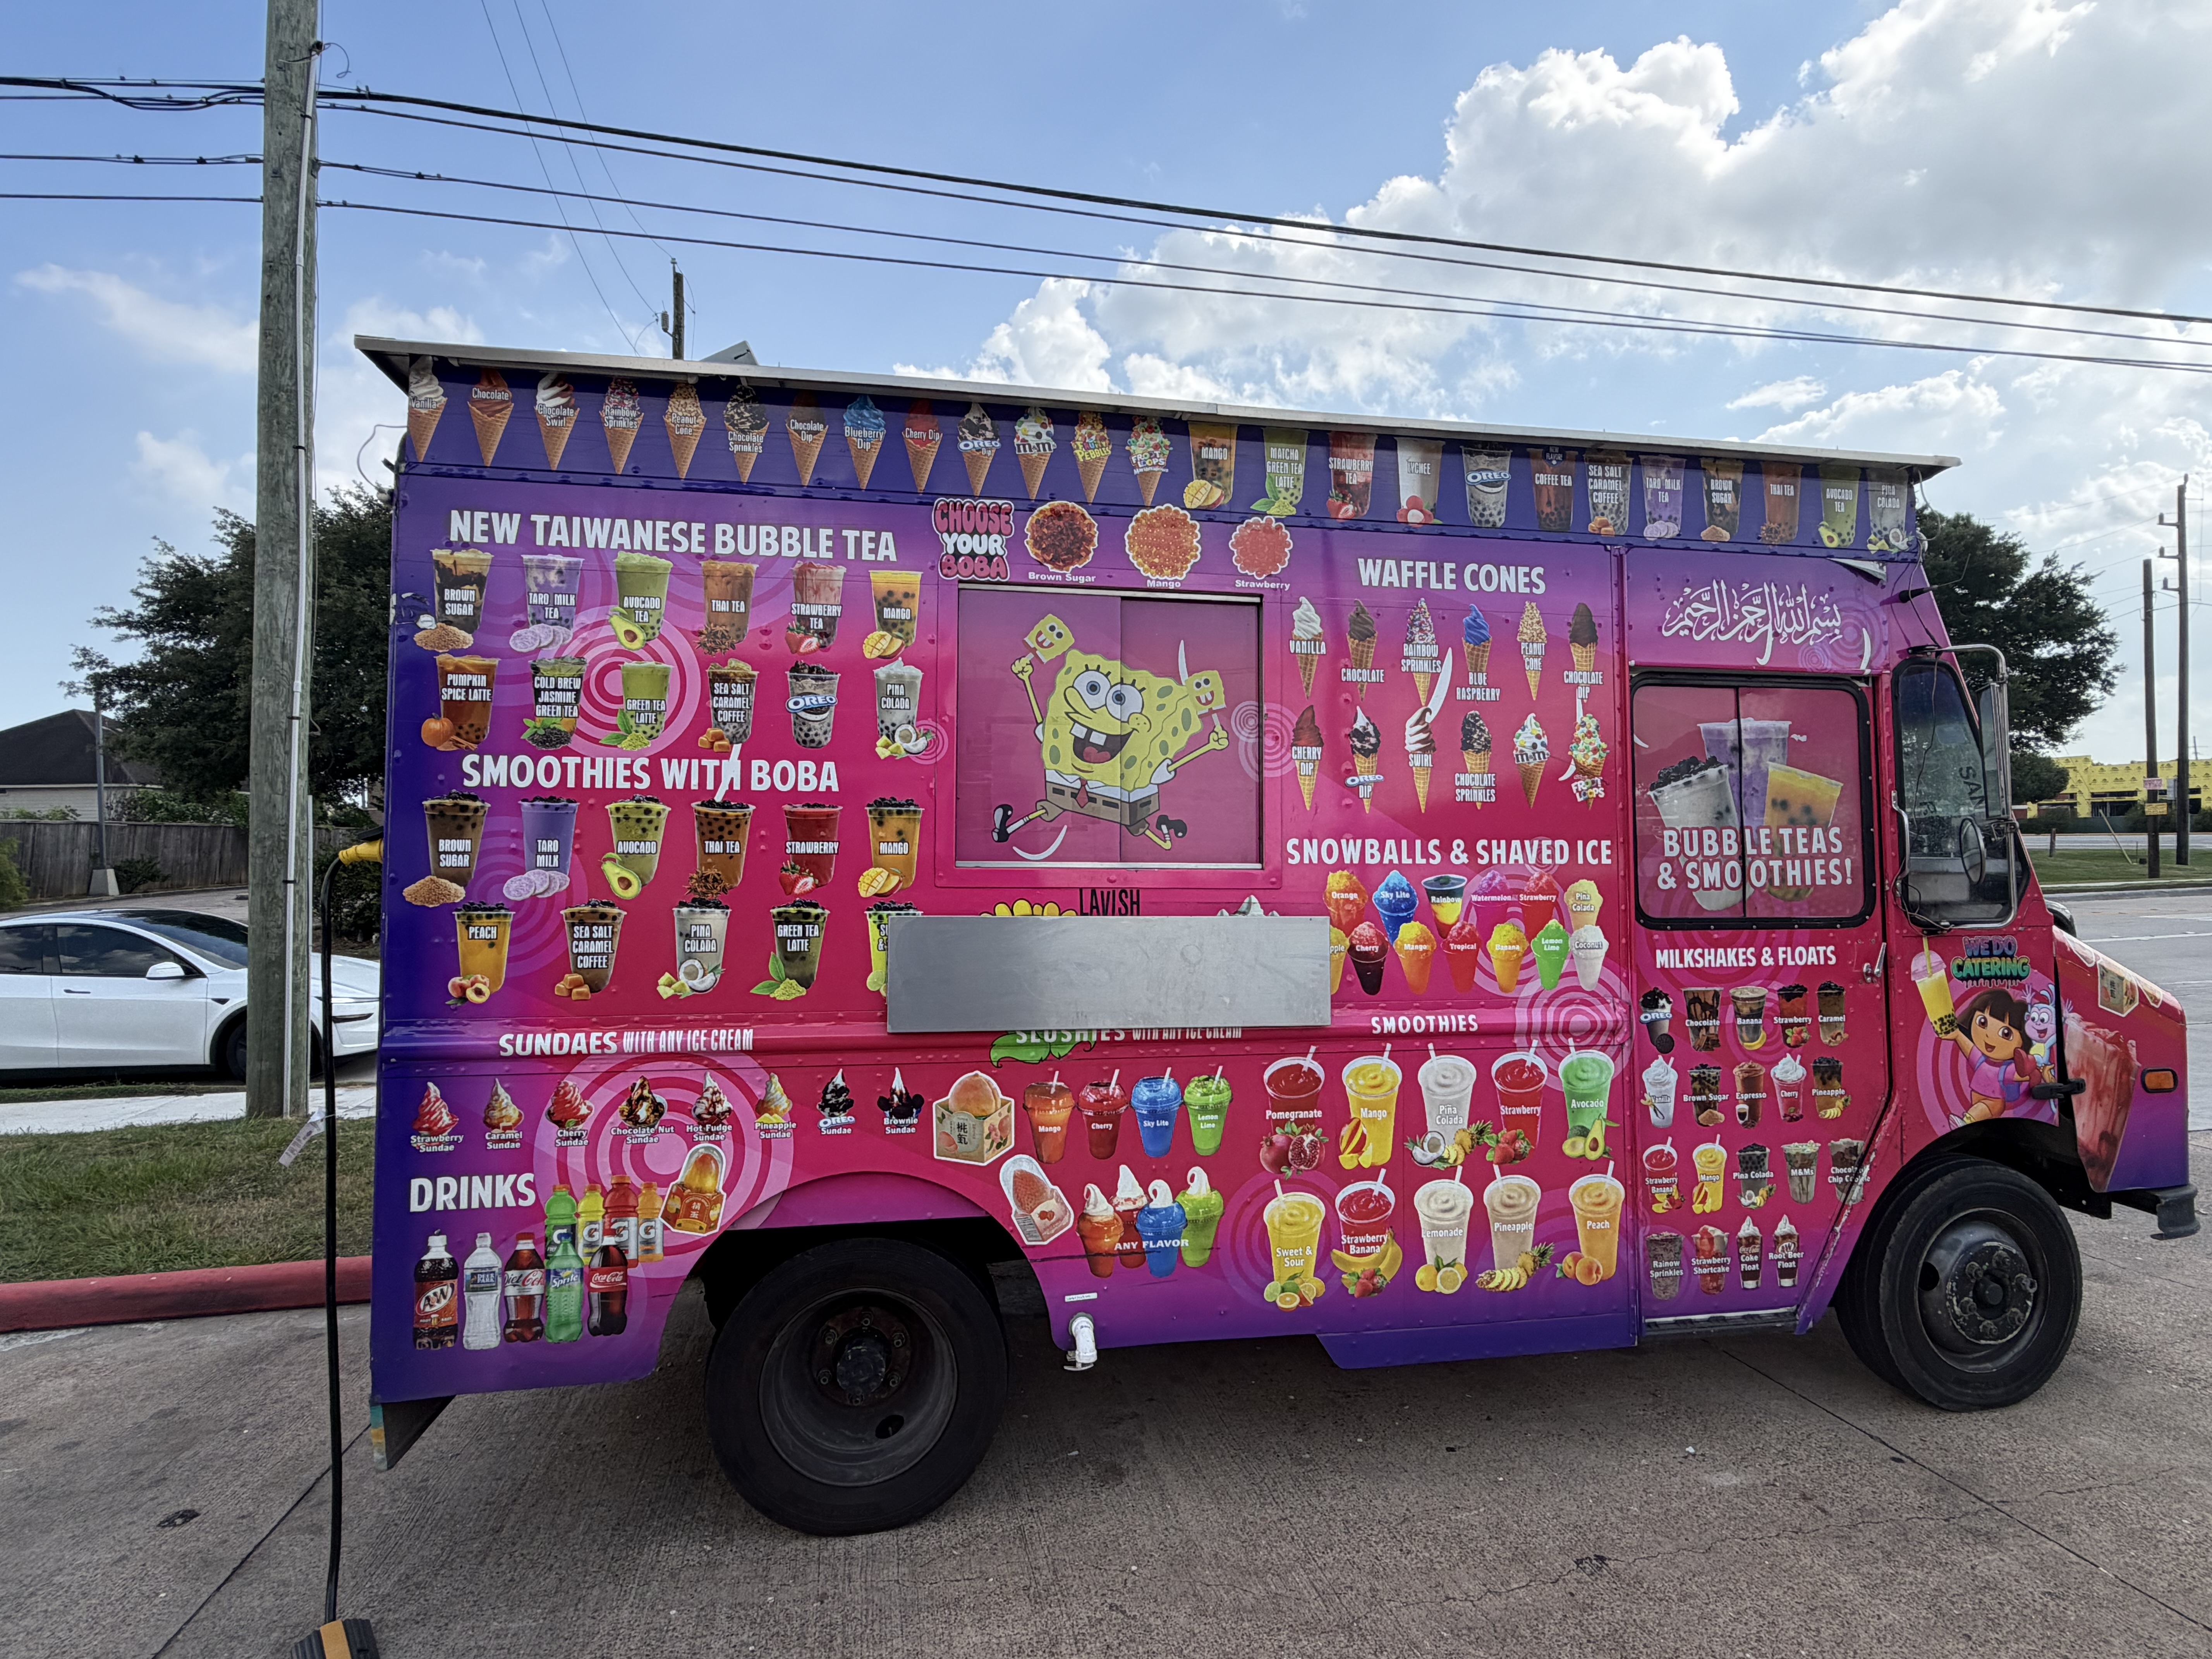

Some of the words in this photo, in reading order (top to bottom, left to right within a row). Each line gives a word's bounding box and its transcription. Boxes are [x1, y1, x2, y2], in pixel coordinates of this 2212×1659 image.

[411, 398, 437, 409] Vanilla
[546, 416, 566, 426] Swirl
[604, 417, 637, 429] Sprinkles
[672, 413, 697, 424] Peanut
[675, 425, 692, 435] Cone
[801, 430, 813, 442] Dip
[845, 426, 884, 440] Blueberry
[905, 428, 926, 441] Cherry
[929, 429, 940, 441] Dip
[1076, 448, 1111, 462] PEBBLES
[1270, 447, 1298, 461] MATCHA
[1138, 459, 1165, 467] LOOPS
[1408, 462, 1431, 475] LYCHEE
[1466, 471, 1510, 484] OREO
[1646, 477, 1661, 489] TARO
[1665, 479, 1681, 490] MILK
[1593, 492, 1619, 503] COFFEE
[935, 501, 1012, 536] CHOOSE
[450, 510, 521, 544] NEW
[531, 514, 706, 553] TAIWANESE
[715, 524, 833, 559] BUBBLE
[842, 529, 897, 562] TEA
[942, 533, 1005, 555] YOUR
[941, 555, 1007, 579] BOBA
[1029, 572, 1061, 581] Brown
[1065, 573, 1096, 584] Sugar
[1358, 558, 1456, 590] WAFFLE
[1464, 563, 1546, 594] CONES
[1147, 580, 1181, 589] Mango
[1235, 580, 1290, 591] Strawberry
[444, 589, 475, 602] BROWN
[623, 596, 660, 609] AVOCADO
[884, 608, 910, 620] MANGO
[1290, 640, 1326, 654] VANILLA
[1403, 643, 1438, 657] RAINBOW
[1521, 642, 1545, 656] PEANUT
[1525, 658, 1542, 670] CONE
[447, 674, 487, 687] PUMPKIN
[1341, 668, 1384, 682] CHOCOLATE
[1469, 672, 1487, 685] BLUE
[534, 677, 555, 689] COLD
[558, 677, 581, 689] BREW
[714, 682, 728, 695] SEA
[731, 683, 750, 695] SALT
[441, 689, 466, 700] SPICE
[468, 689, 492, 702] LATTE
[887, 684, 904, 696] PINA
[1456, 687, 1500, 701] RASPBERRY
[538, 691, 576, 703] JASMINE
[787, 695, 836, 711] OREO
[881, 697, 910, 709] COLADA
[627, 699, 650, 711] GREEN
[653, 700, 666, 711] TEA
[1409, 754, 1432, 767] SWIRL
[462, 754, 651, 790] SMOOTHIES
[661, 758, 741, 790] WITH
[751, 759, 839, 792] BOBA
[537, 840, 558, 852] TARO
[705, 841, 723, 853] THAI
[726, 841, 740, 853] TEA
[1663, 828, 1772, 857] BUBBLE
[1779, 827, 1842, 854] TEAS
[1287, 838, 1441, 864] SNOWBALLS
[1451, 839, 1469, 865] &
[1476, 839, 1569, 865] SHAVED
[1577, 840, 1612, 864] ICE
[440, 854, 469, 867] SUGAR
[536, 854, 558, 867] MILK
[1657, 862, 1676, 889] &
[1686, 858, 1852, 889] SMOOTHIES!
[1331, 891, 1358, 900] Orange
[1381, 891, 1394, 900] Sky
[1079, 888, 1140, 916] LAVISH
[469, 926, 496, 939] PEACH
[574, 926, 589, 938] SEA
[592, 926, 612, 938] SALT
[691, 925, 711, 938] PINA
[684, 939, 716, 953] COLADA
[787, 939, 809, 952] LATTE
[1449, 943, 1476, 951] Tropical
[1575, 941, 1602, 950] Coconut
[1963, 937, 1990, 957] WE
[1992, 936, 2017, 956] DO
[577, 955, 608, 968] COFFEE
[1656, 947, 1756, 968] MILKSHAKES
[1761, 947, 1774, 965] &
[1778, 946, 1836, 966] FLOATS
[1951, 957, 2030, 980] CATERING
[1371, 1014, 1479, 1034] SMOOTHIES
[499, 1032, 617, 1056] SUNDAES
[623, 1031, 655, 1053] WITH
[659, 1030, 683, 1052] ANY
[687, 1029, 707, 1051] ICE
[711, 1029, 754, 1051] CREAM
[1439, 1104, 1457, 1115] Piña
[1571, 1099, 1604, 1109] Avocado
[884, 1117, 918, 1125] Brownie
[1266, 1109, 1322, 1121] Pomegranate
[611, 1127, 655, 1135] Chocolate
[658, 1125, 674, 1133] Nut
[687, 1125, 703, 1133] Hot
[706, 1123, 732, 1133] Fudge
[755, 1121, 796, 1131] Pineapple
[821, 1127, 852, 1135] Sundae
[485, 1131, 522, 1140] Caramel
[557, 1129, 587, 1139] Cherry
[486, 1141, 520, 1150] Sundae
[1828, 1176, 1843, 1184] Chip
[410, 1173, 536, 1212] DRINKS
[1494, 1221, 1533, 1233] Pineapple
[1587, 1219, 1610, 1230] Peach
[1341, 1234, 1388, 1244] Strawberry
[1422, 1228, 1463, 1238] Lemonade
[1114, 1241, 1138, 1251] ANY
[1142, 1239, 1189, 1249] FLAVOR
[1350, 1244, 1381, 1254] Banana
[1285, 1257, 1304, 1267] Sour
[1650, 1269, 1684, 1278] Sprinkles
[1693, 1265, 1730, 1274] Shortcake
[552, 1274, 579, 1288] Sprite
